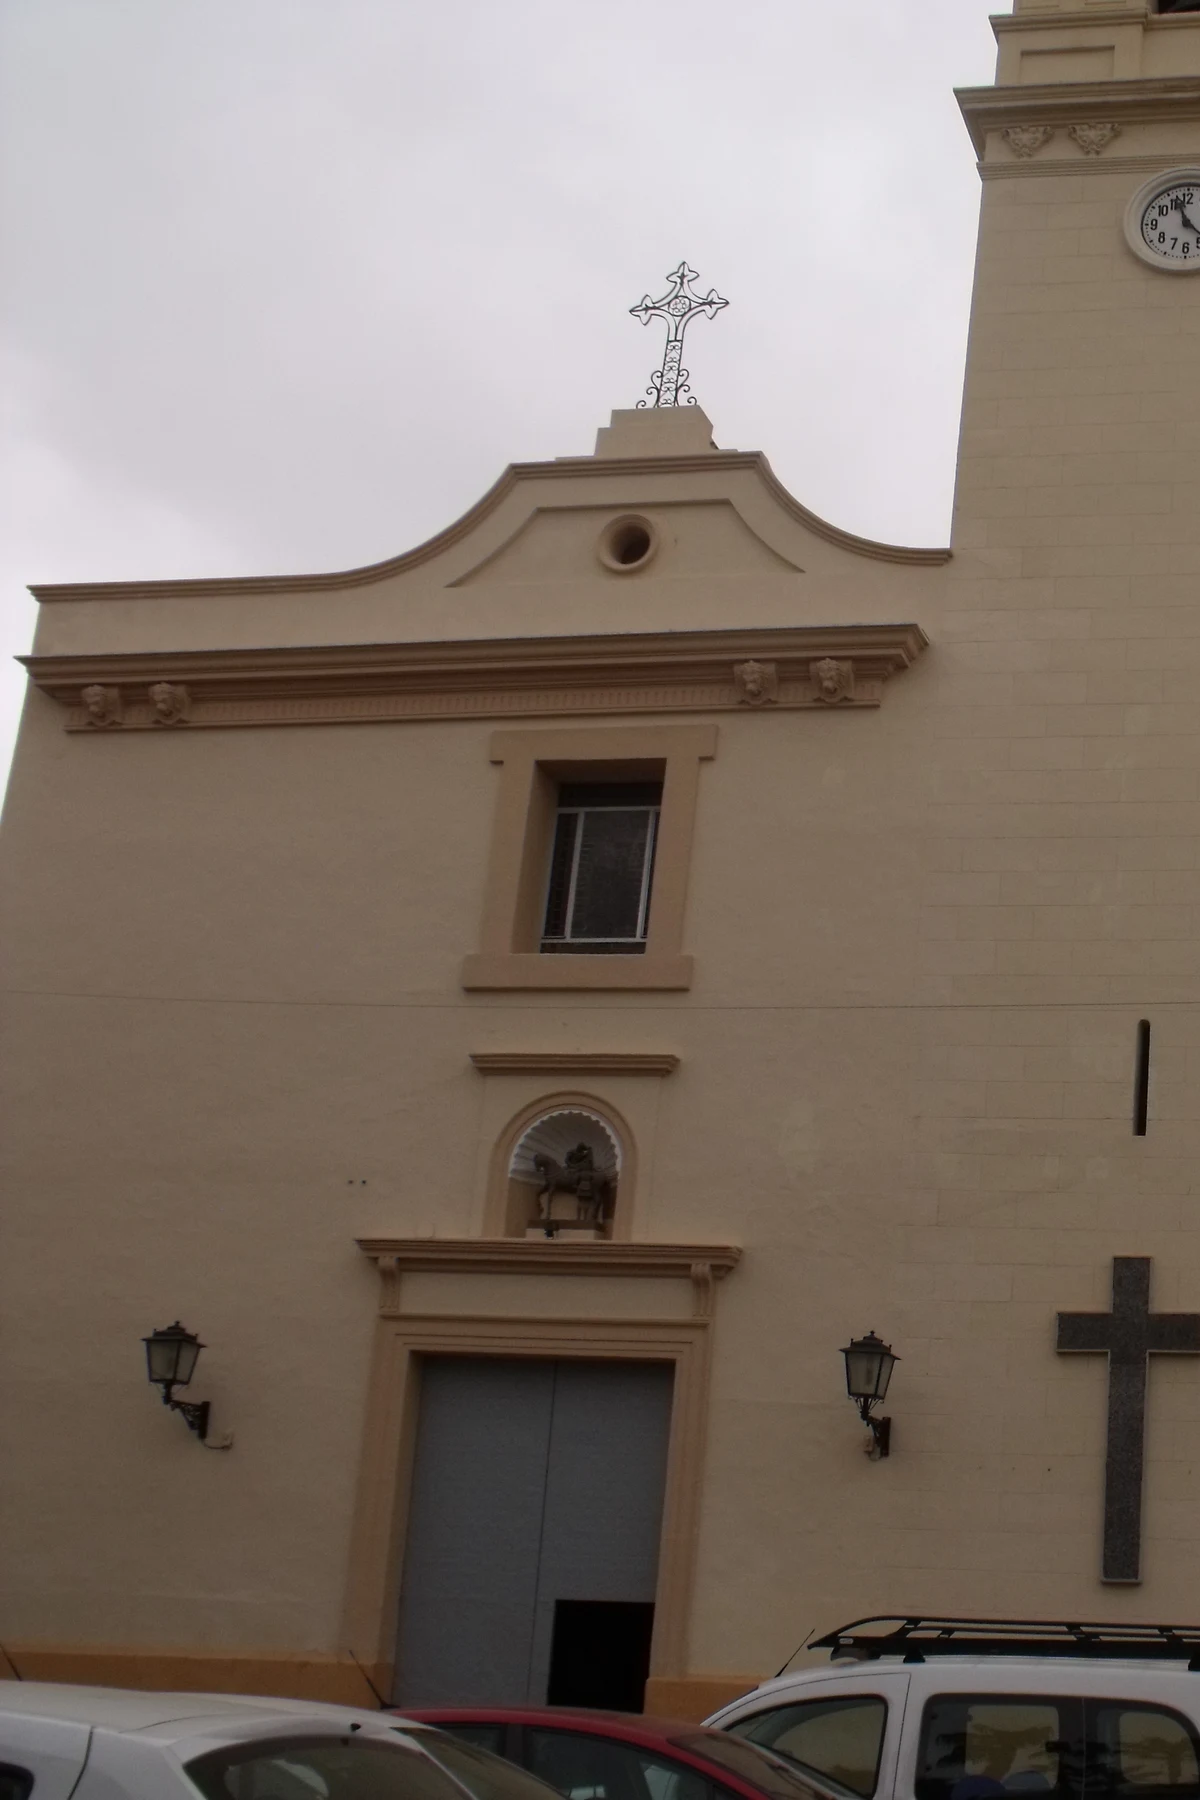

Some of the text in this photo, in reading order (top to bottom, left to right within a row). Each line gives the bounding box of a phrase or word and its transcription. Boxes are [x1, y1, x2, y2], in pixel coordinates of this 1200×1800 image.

[1170, 199, 1177, 211] 11
[1182, 192, 1194, 205] 12
[1158, 204, 1169, 217] 10
[1150, 218, 1158, 231] 9
[1158, 231, 1165, 243] 8
[1170, 237, 1178, 250] 7
[1182, 242, 1189, 254] 6
